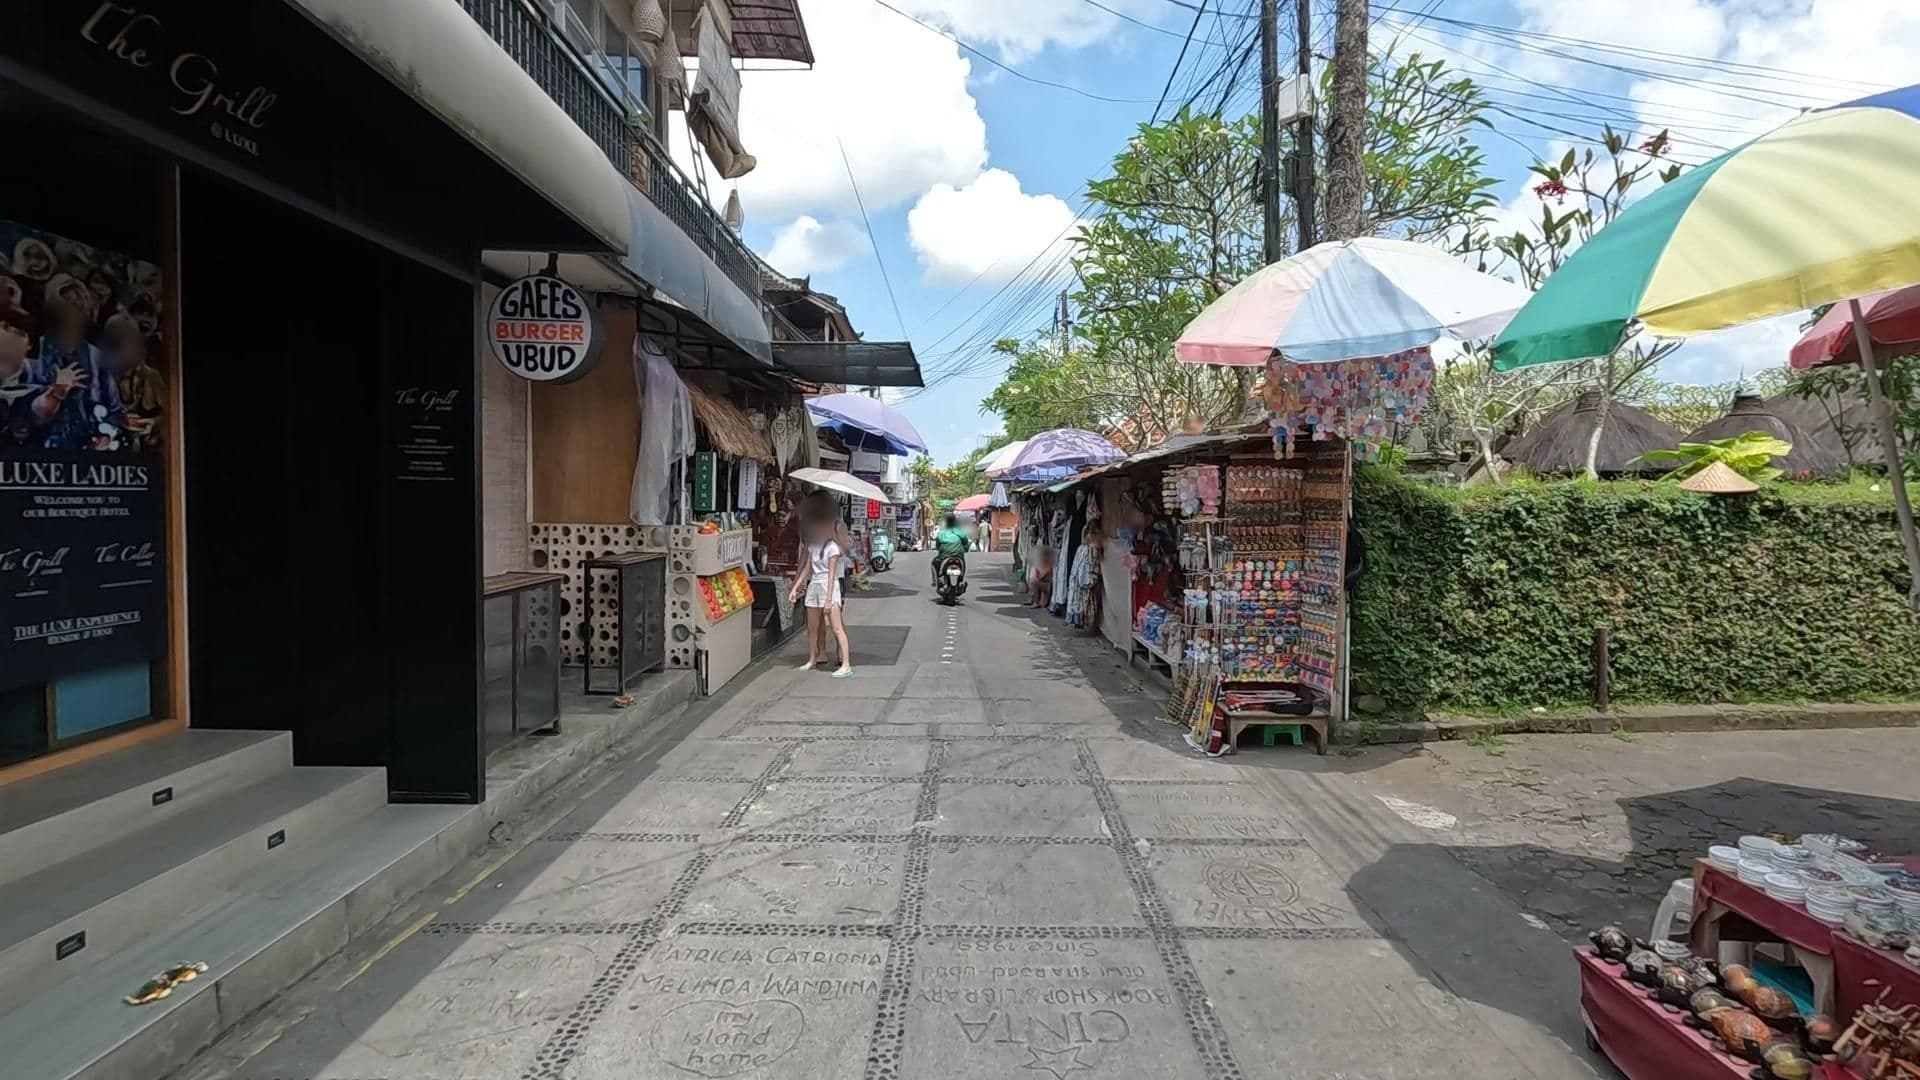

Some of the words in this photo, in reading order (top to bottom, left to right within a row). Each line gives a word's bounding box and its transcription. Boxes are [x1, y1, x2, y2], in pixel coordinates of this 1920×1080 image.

[80, 2, 161, 68] The
[169, 52, 278, 129] Grill
[499, 278, 582, 319] GAEES
[495, 322, 584, 341] BURGER
[502, 343, 576, 373] UBUD
[0, 461, 65, 485] LUXE
[72, 463, 149, 486] LADIES
[33, 495, 86, 505] WELCOME
[108, 496, 121, 505] TO
[47, 507, 97, 519] BOUTIQUE
[99, 506, 131, 517] HOTEL
[22, 546, 71, 577] Grill
[13, 625, 40, 639] THE
[42, 618, 75, 633] LUXE
[75, 610, 141, 628] EXPERIENCE
[1027, 941, 1099, 957] Since
[953, 1009, 1131, 1045] CINTA
